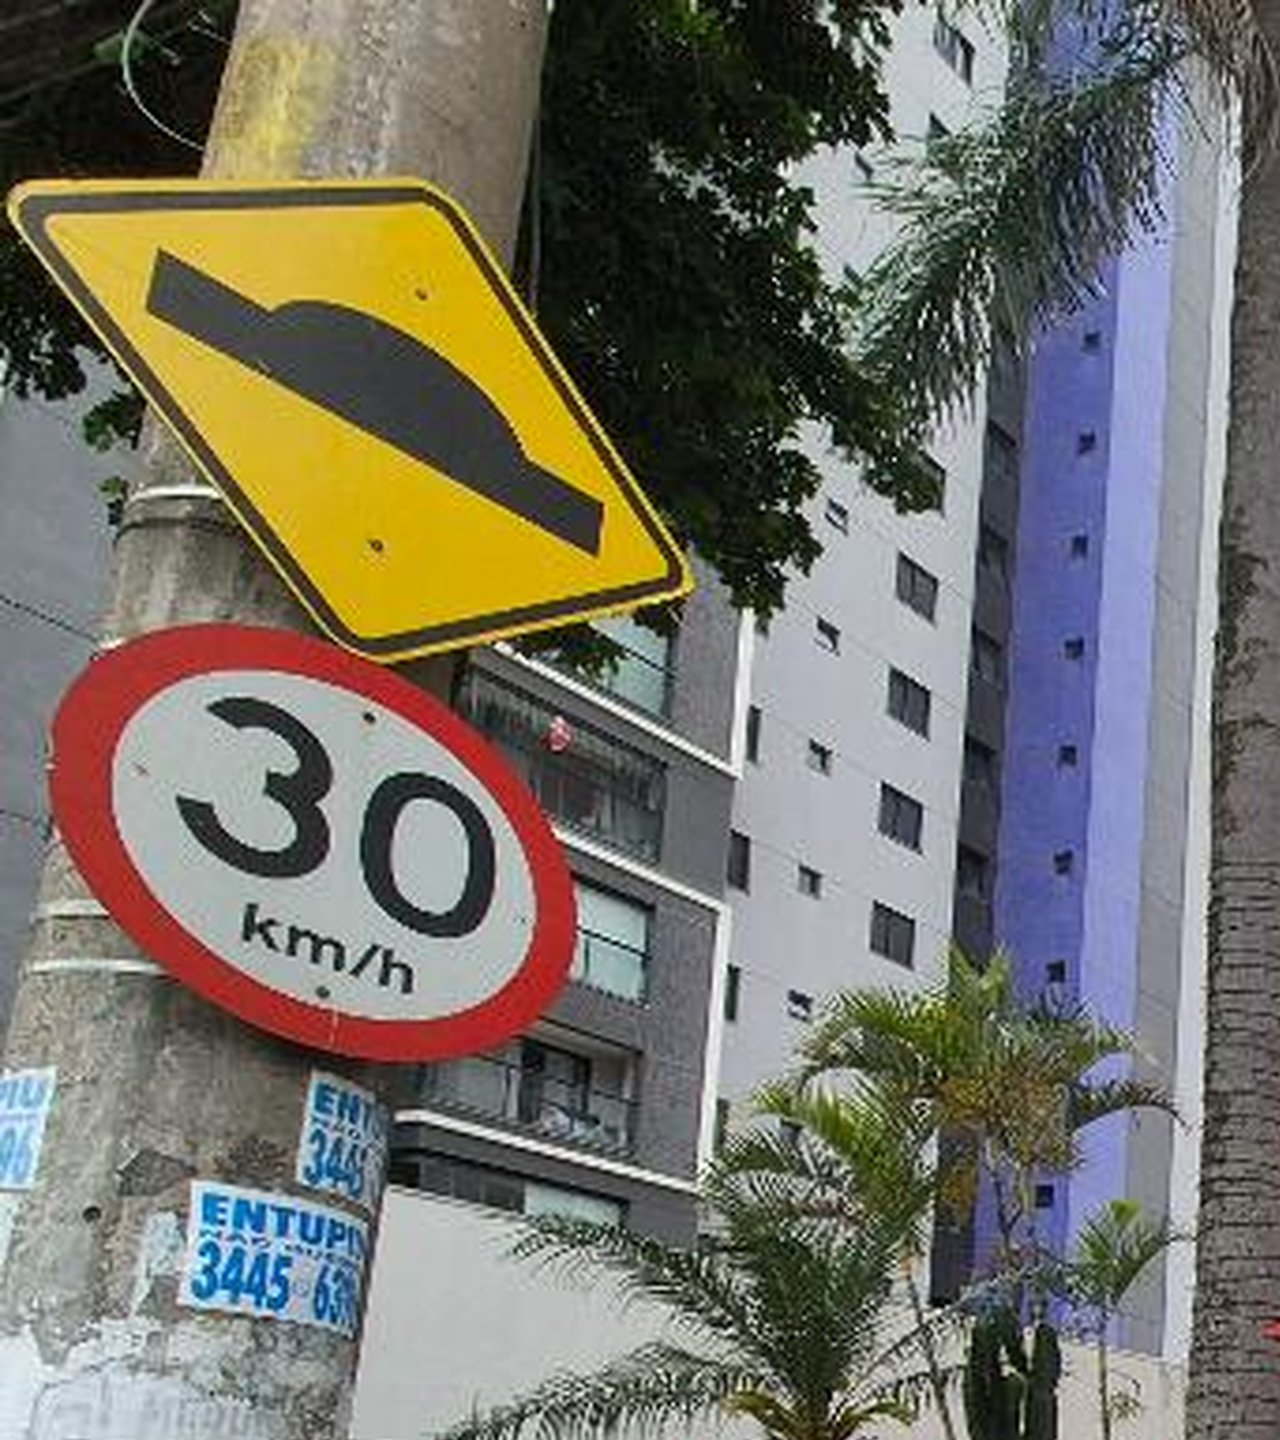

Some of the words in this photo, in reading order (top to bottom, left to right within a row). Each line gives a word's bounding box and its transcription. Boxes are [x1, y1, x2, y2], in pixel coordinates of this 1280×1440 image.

[176, 697, 496, 938] 30
[240, 903, 414, 994] km/h
[191, 1241, 292, 1310] 3445
